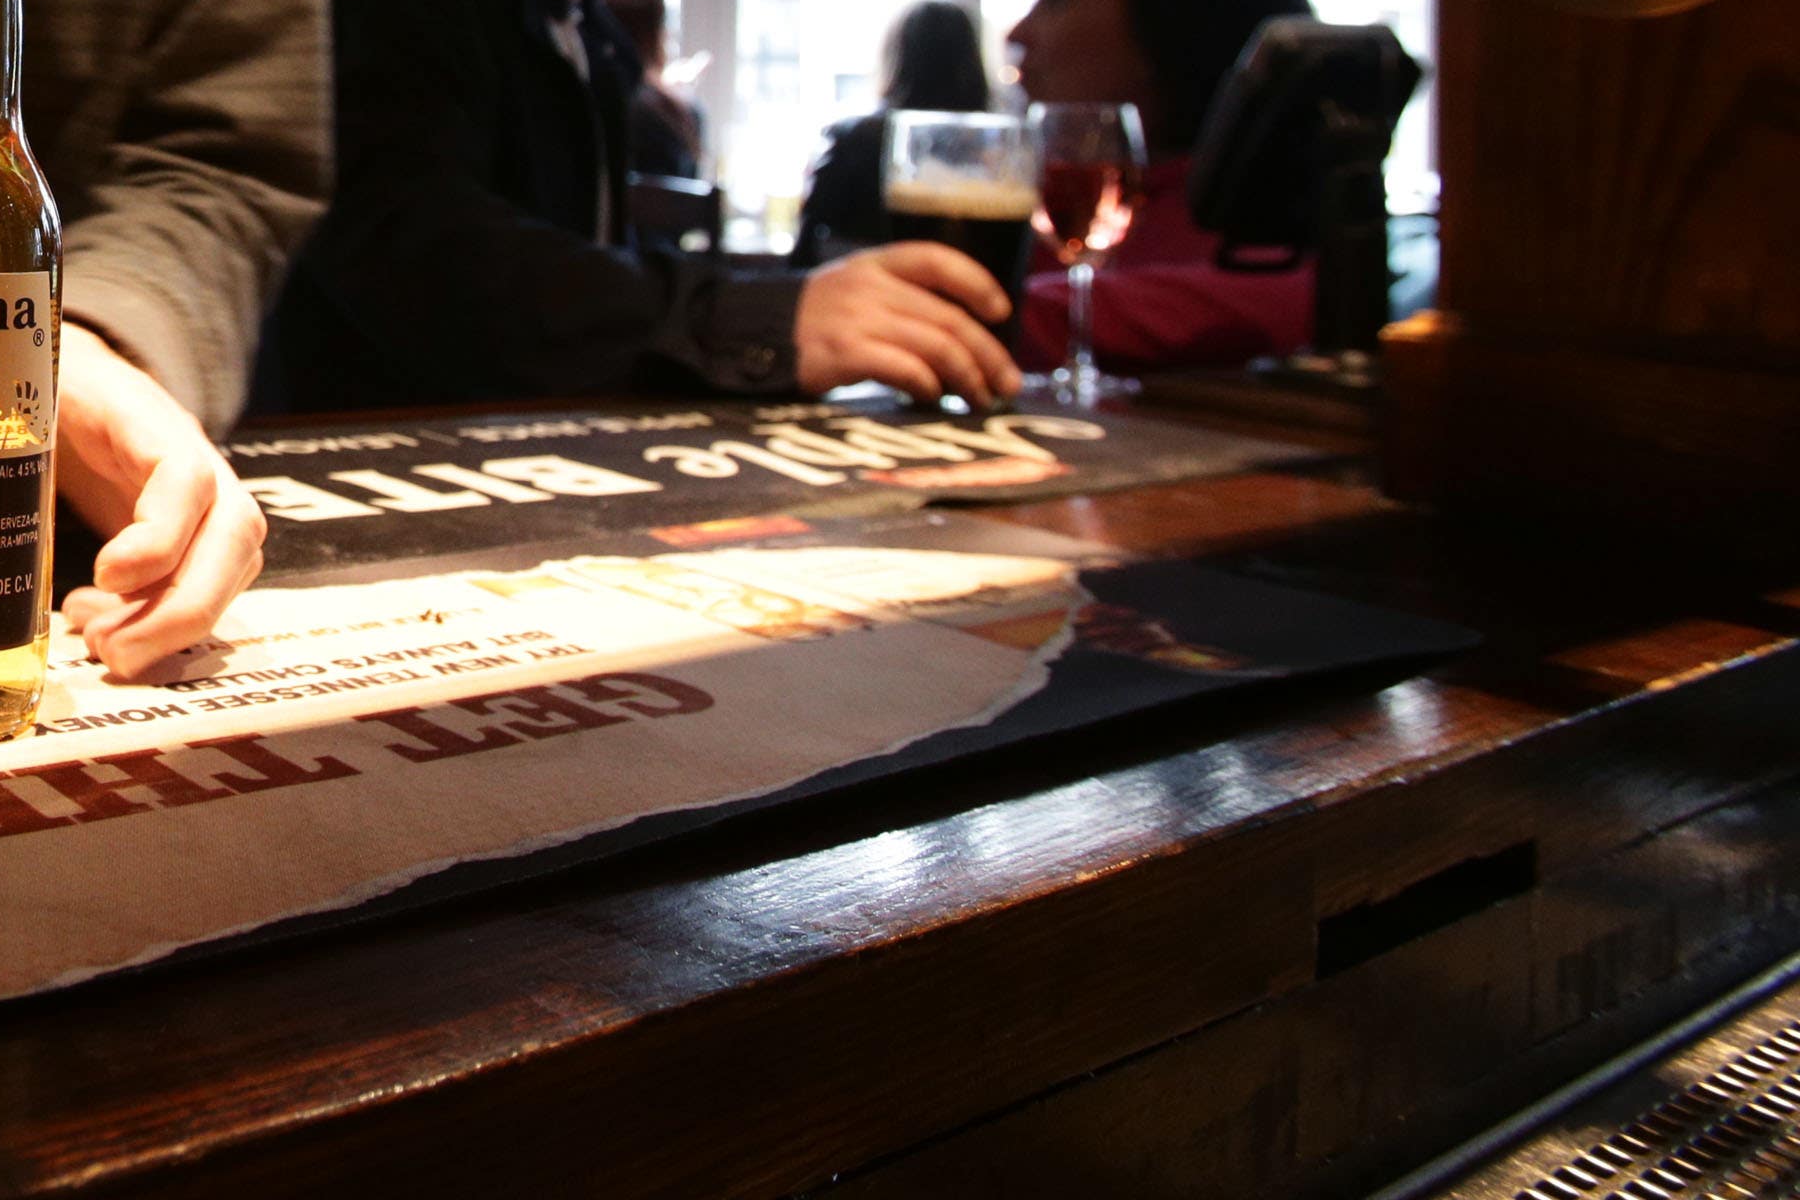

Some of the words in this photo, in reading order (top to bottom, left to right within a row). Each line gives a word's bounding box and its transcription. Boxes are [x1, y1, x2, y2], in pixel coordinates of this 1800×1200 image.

[643, 414, 1106, 488] Apple
[14, 573, 34, 593] C.V.
[487, 629, 558, 647] BUT
[525, 644, 597, 660] TRY
[330, 640, 480, 670] ALWAYS
[432, 654, 522, 676] NEW
[187, 668, 432, 712] TENNESSEE
[33, 703, 191, 737] HONEY
[352, 672, 716, 764] GET
